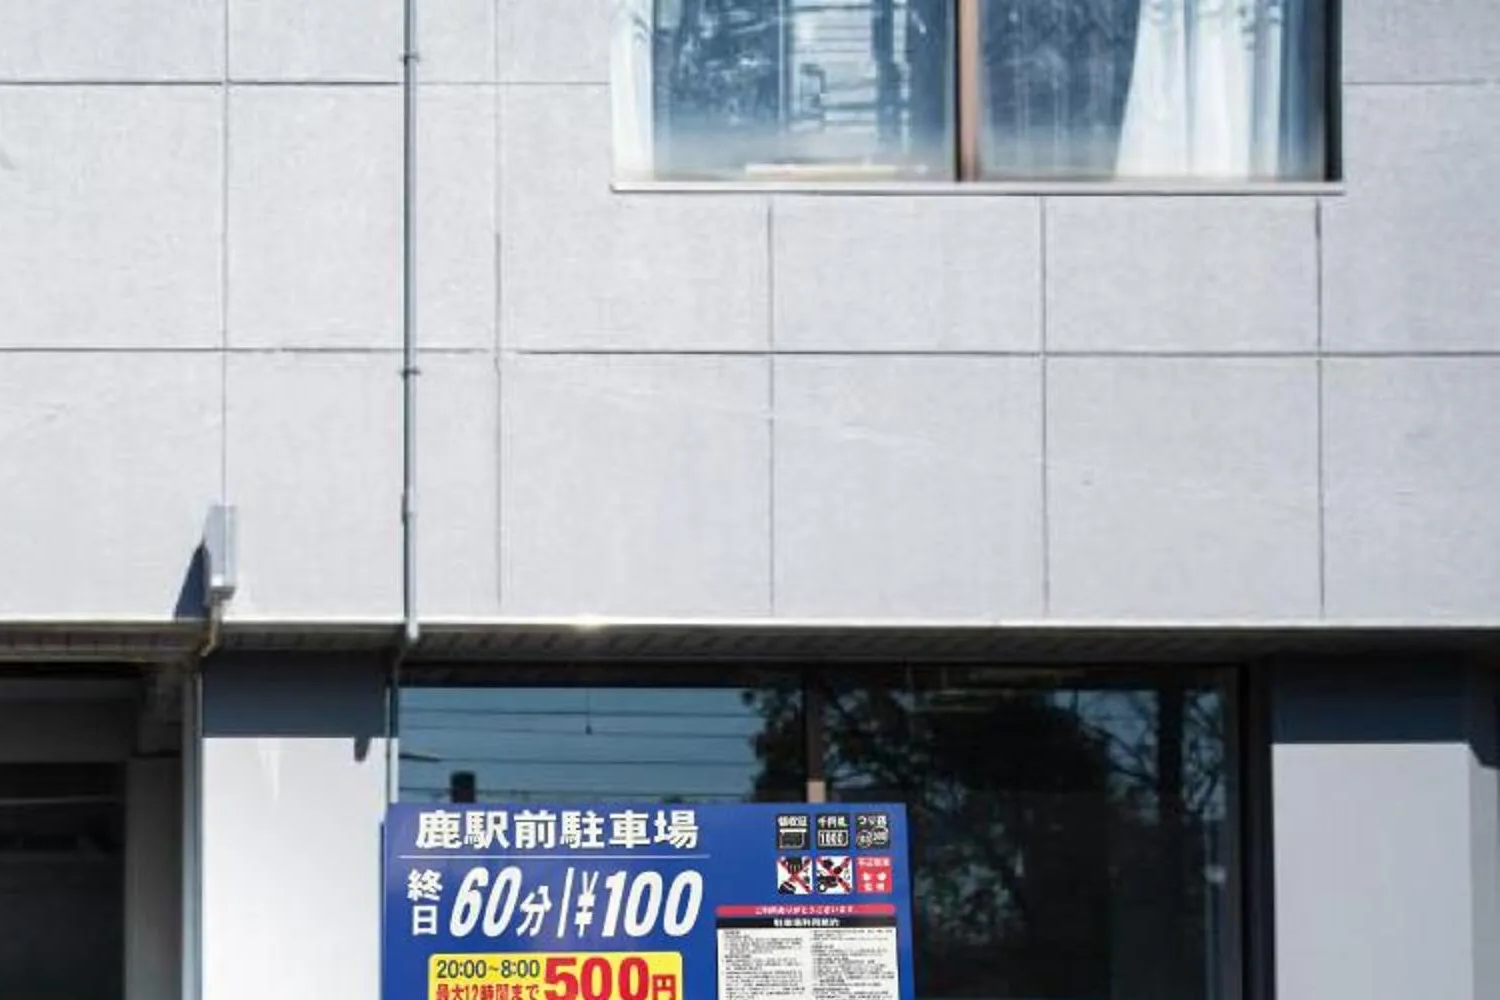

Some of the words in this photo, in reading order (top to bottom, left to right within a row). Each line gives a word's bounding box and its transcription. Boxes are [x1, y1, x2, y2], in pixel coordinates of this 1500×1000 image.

[416, 809, 699, 849] 鹿駅前駐車場
[406, 868, 443, 936] 終日
